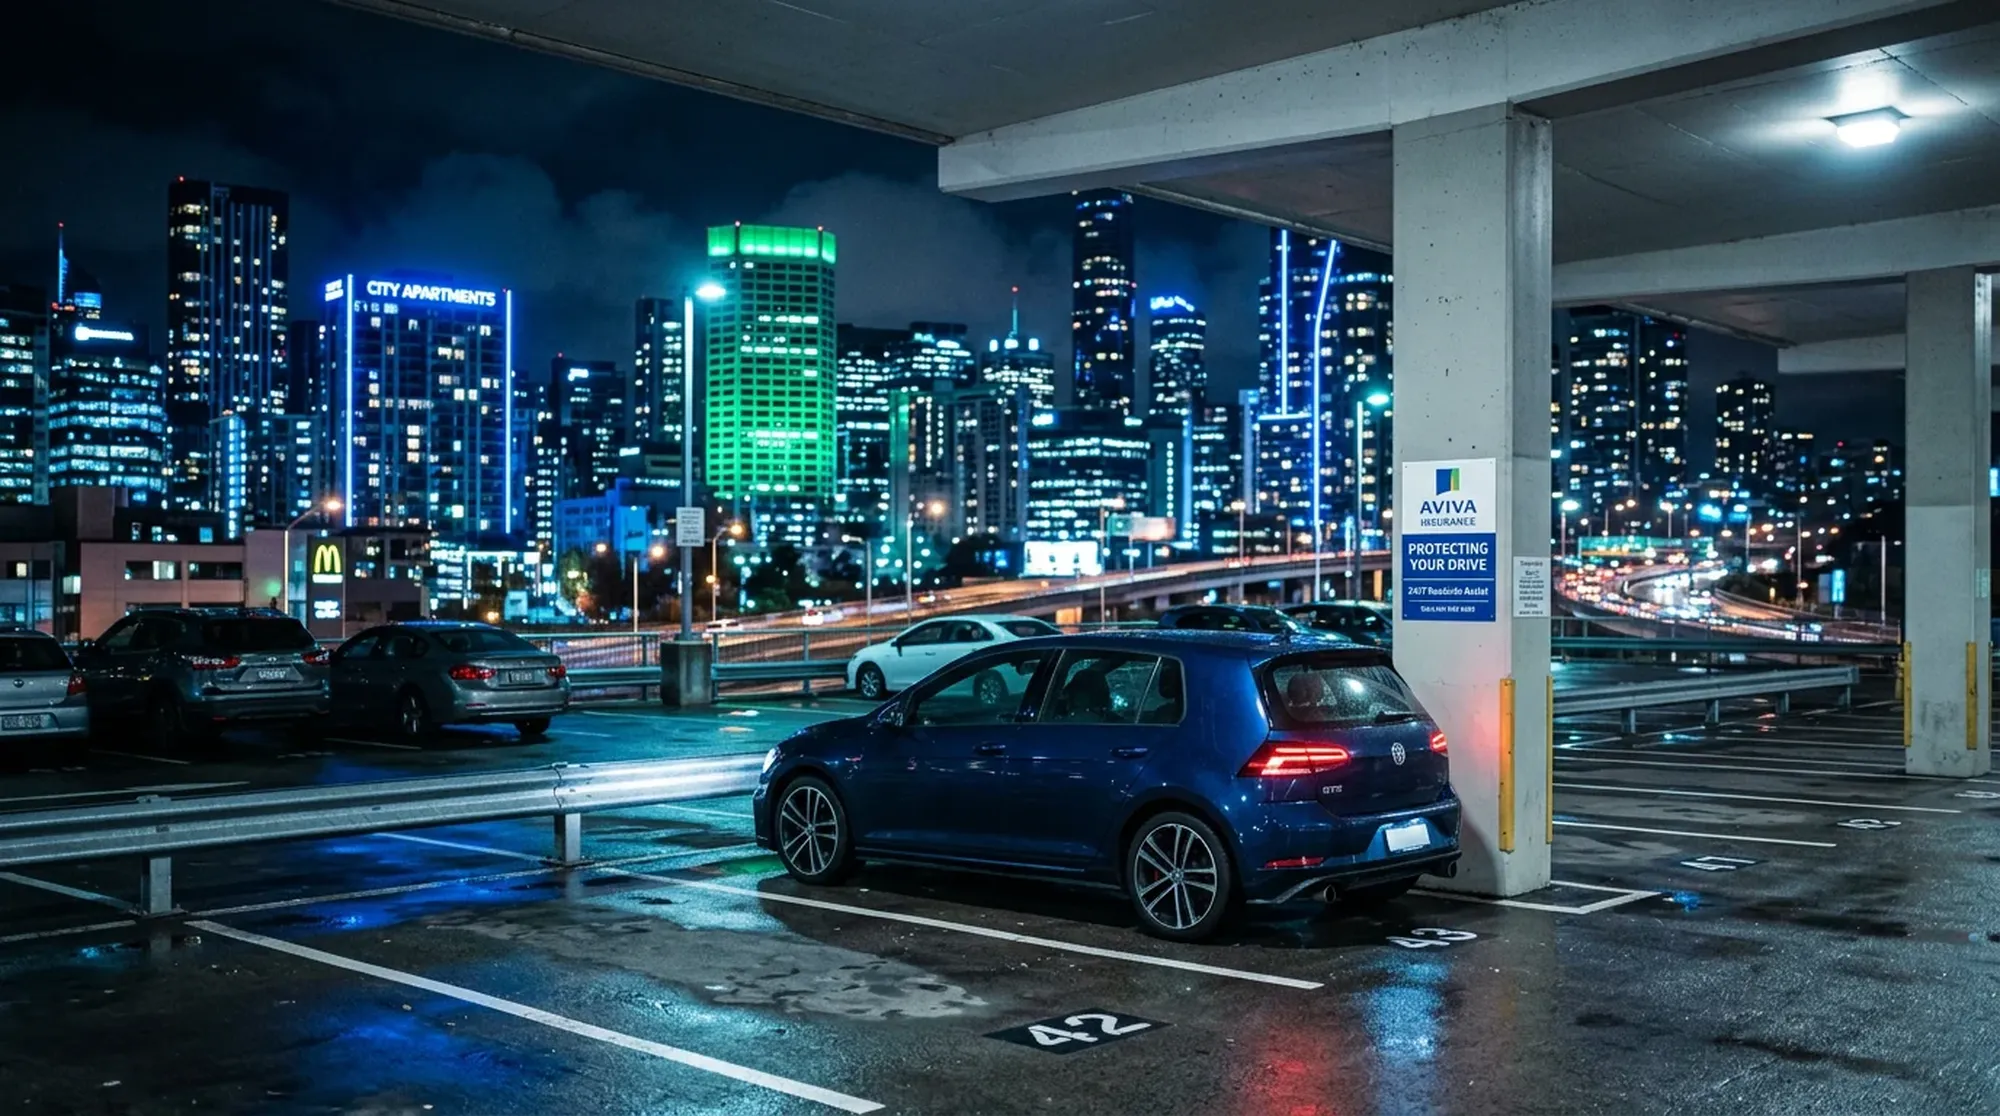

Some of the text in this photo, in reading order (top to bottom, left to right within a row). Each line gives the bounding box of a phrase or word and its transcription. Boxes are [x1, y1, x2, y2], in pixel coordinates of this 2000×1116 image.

[366, 280, 400, 297] CITY
[402, 284, 496, 307] APARTMENTS
[1420, 499, 1477, 514] AVIVA
[1408, 542, 1489, 555] PROTECTING
[1409, 558, 1487, 571] YOUR DRIVE
[1385, 928, 1478, 949] 43
[1028, 1013, 1152, 1046] 42
